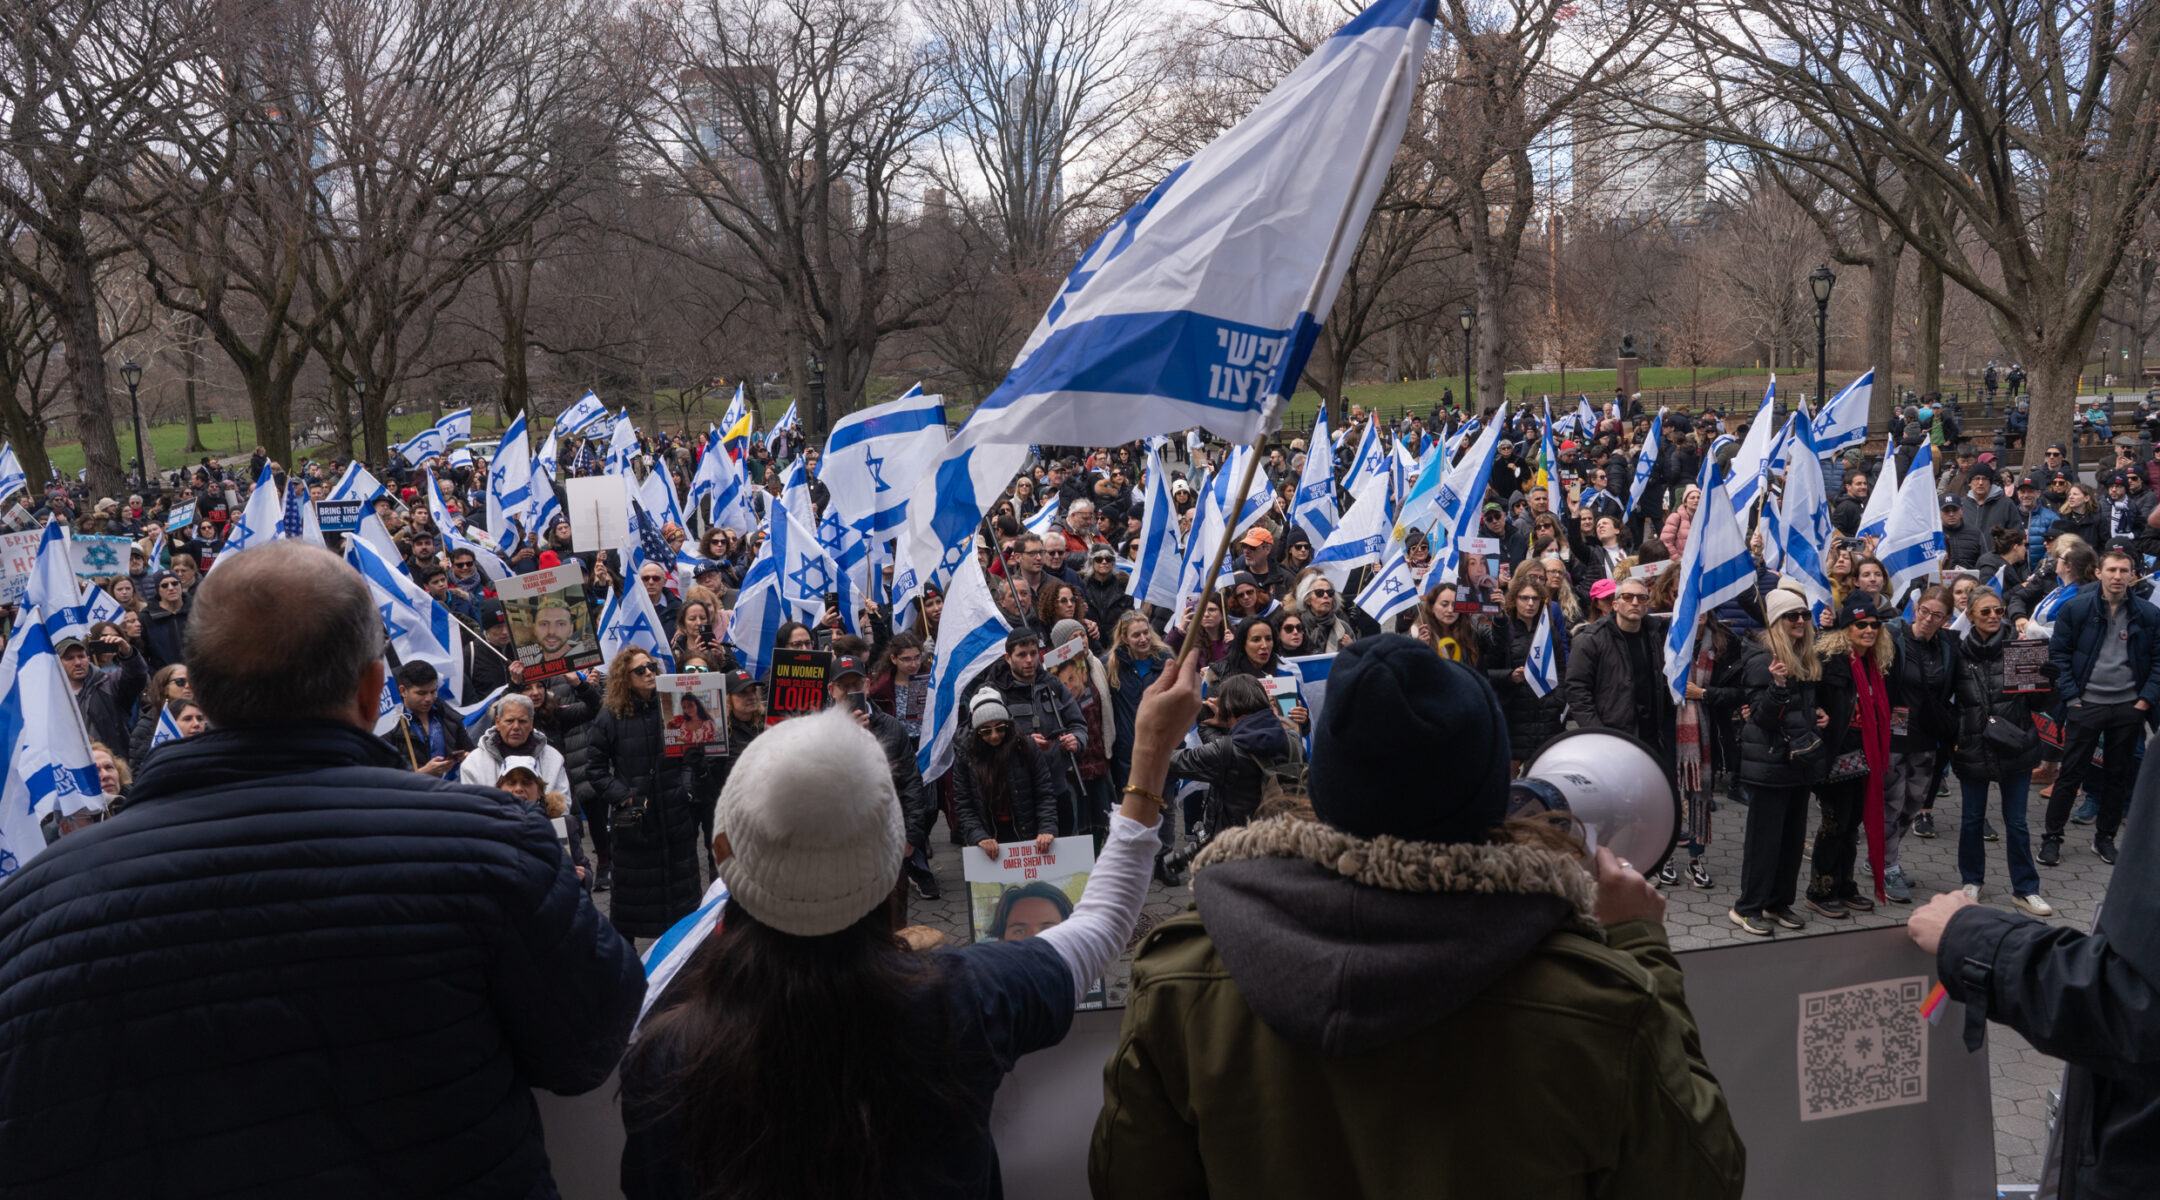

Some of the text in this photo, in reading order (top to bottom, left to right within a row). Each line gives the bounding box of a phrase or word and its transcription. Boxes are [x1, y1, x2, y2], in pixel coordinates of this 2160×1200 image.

[320, 506, 341, 516] BRING
[320, 515, 341, 524] HOME
[4, 535, 40, 547] BRIN
[517, 643, 541, 658] BRING
[523, 664, 544, 678] HOME
[544, 657, 567, 673] NOW!
[777, 664, 825, 679] UN WOMEN
[774, 687, 822, 711] LOUD
[1004, 855, 1056, 869] OMER SHEM TOV
[1025, 868, 1037, 879] (21)
